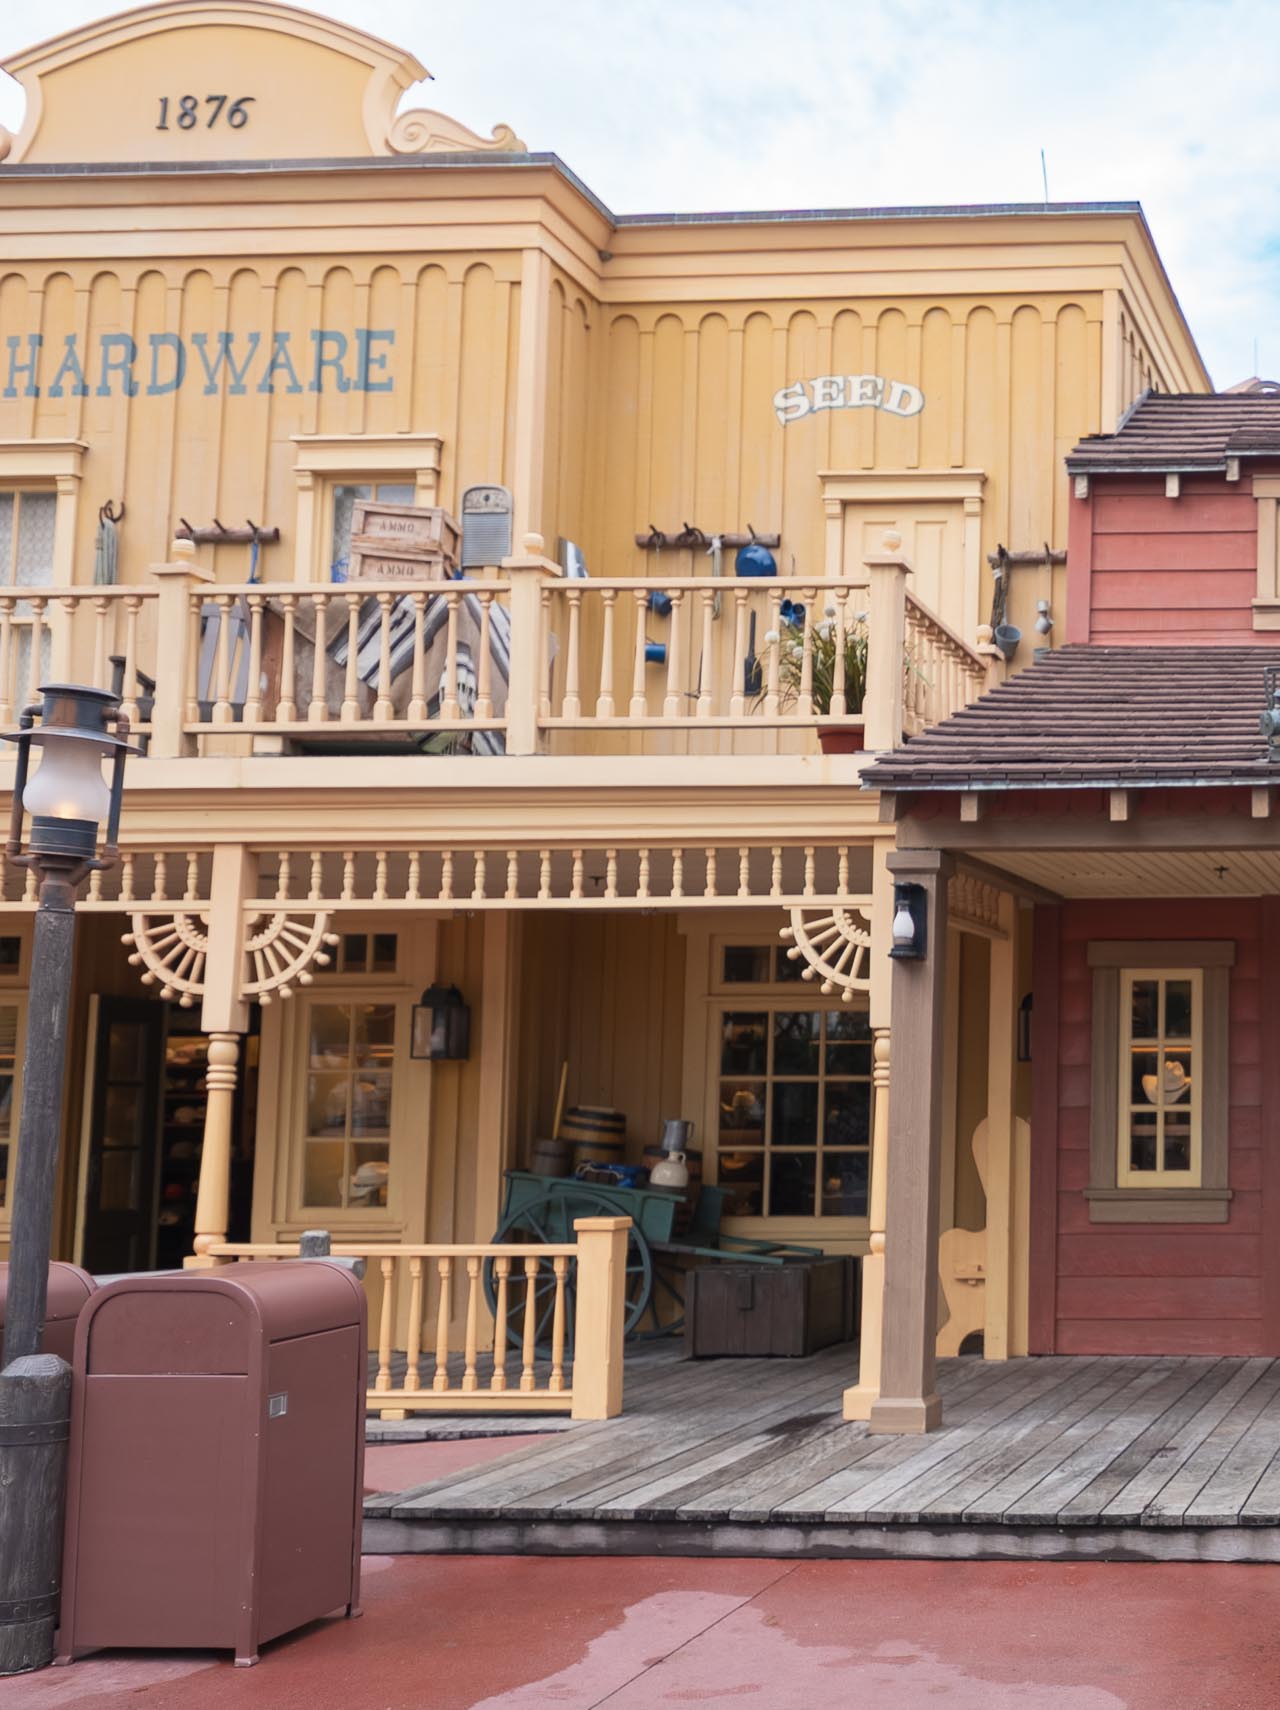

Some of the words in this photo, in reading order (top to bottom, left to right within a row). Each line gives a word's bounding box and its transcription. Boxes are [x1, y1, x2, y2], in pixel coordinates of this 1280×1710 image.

[155, 95, 255, 131] 1876
[3, 328, 396, 398] HARDWARE
[773, 374, 925, 427] SEED
[379, 522, 415, 533] AMMO
[376, 565, 415, 576] AMMO
